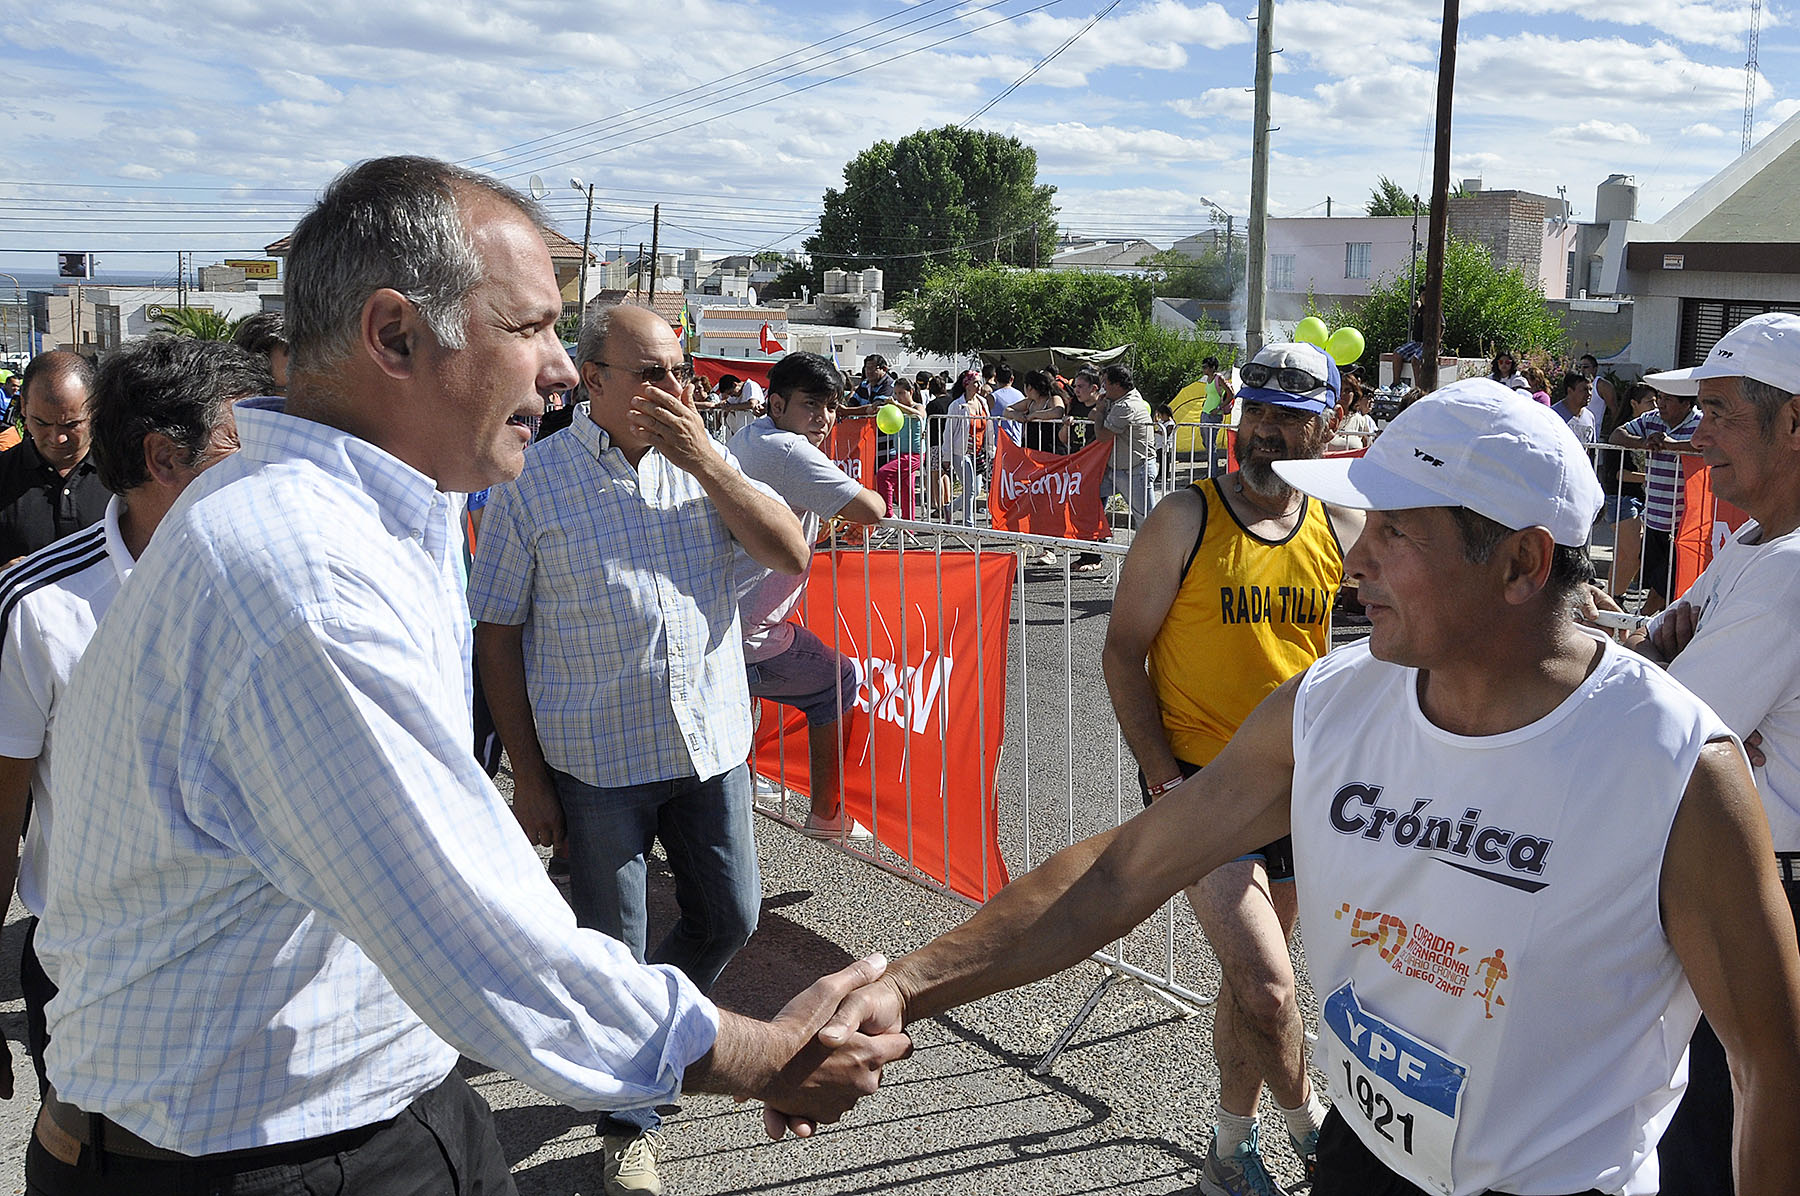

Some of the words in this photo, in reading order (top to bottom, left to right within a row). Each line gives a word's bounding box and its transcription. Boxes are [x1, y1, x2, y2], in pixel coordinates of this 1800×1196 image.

[1414, 447, 1445, 468] YPF
[1220, 586, 1271, 624] RADA
[1279, 586, 1330, 625] TILLY
[1328, 782, 1554, 876] Crónica
[1413, 923, 1455, 956] CORRIDA
[1405, 966, 1435, 984] DIEGO
[1435, 976, 1466, 998] ZAMIT
[1346, 1009, 1427, 1082] YPF
[1342, 1059, 1415, 1156] 1921
